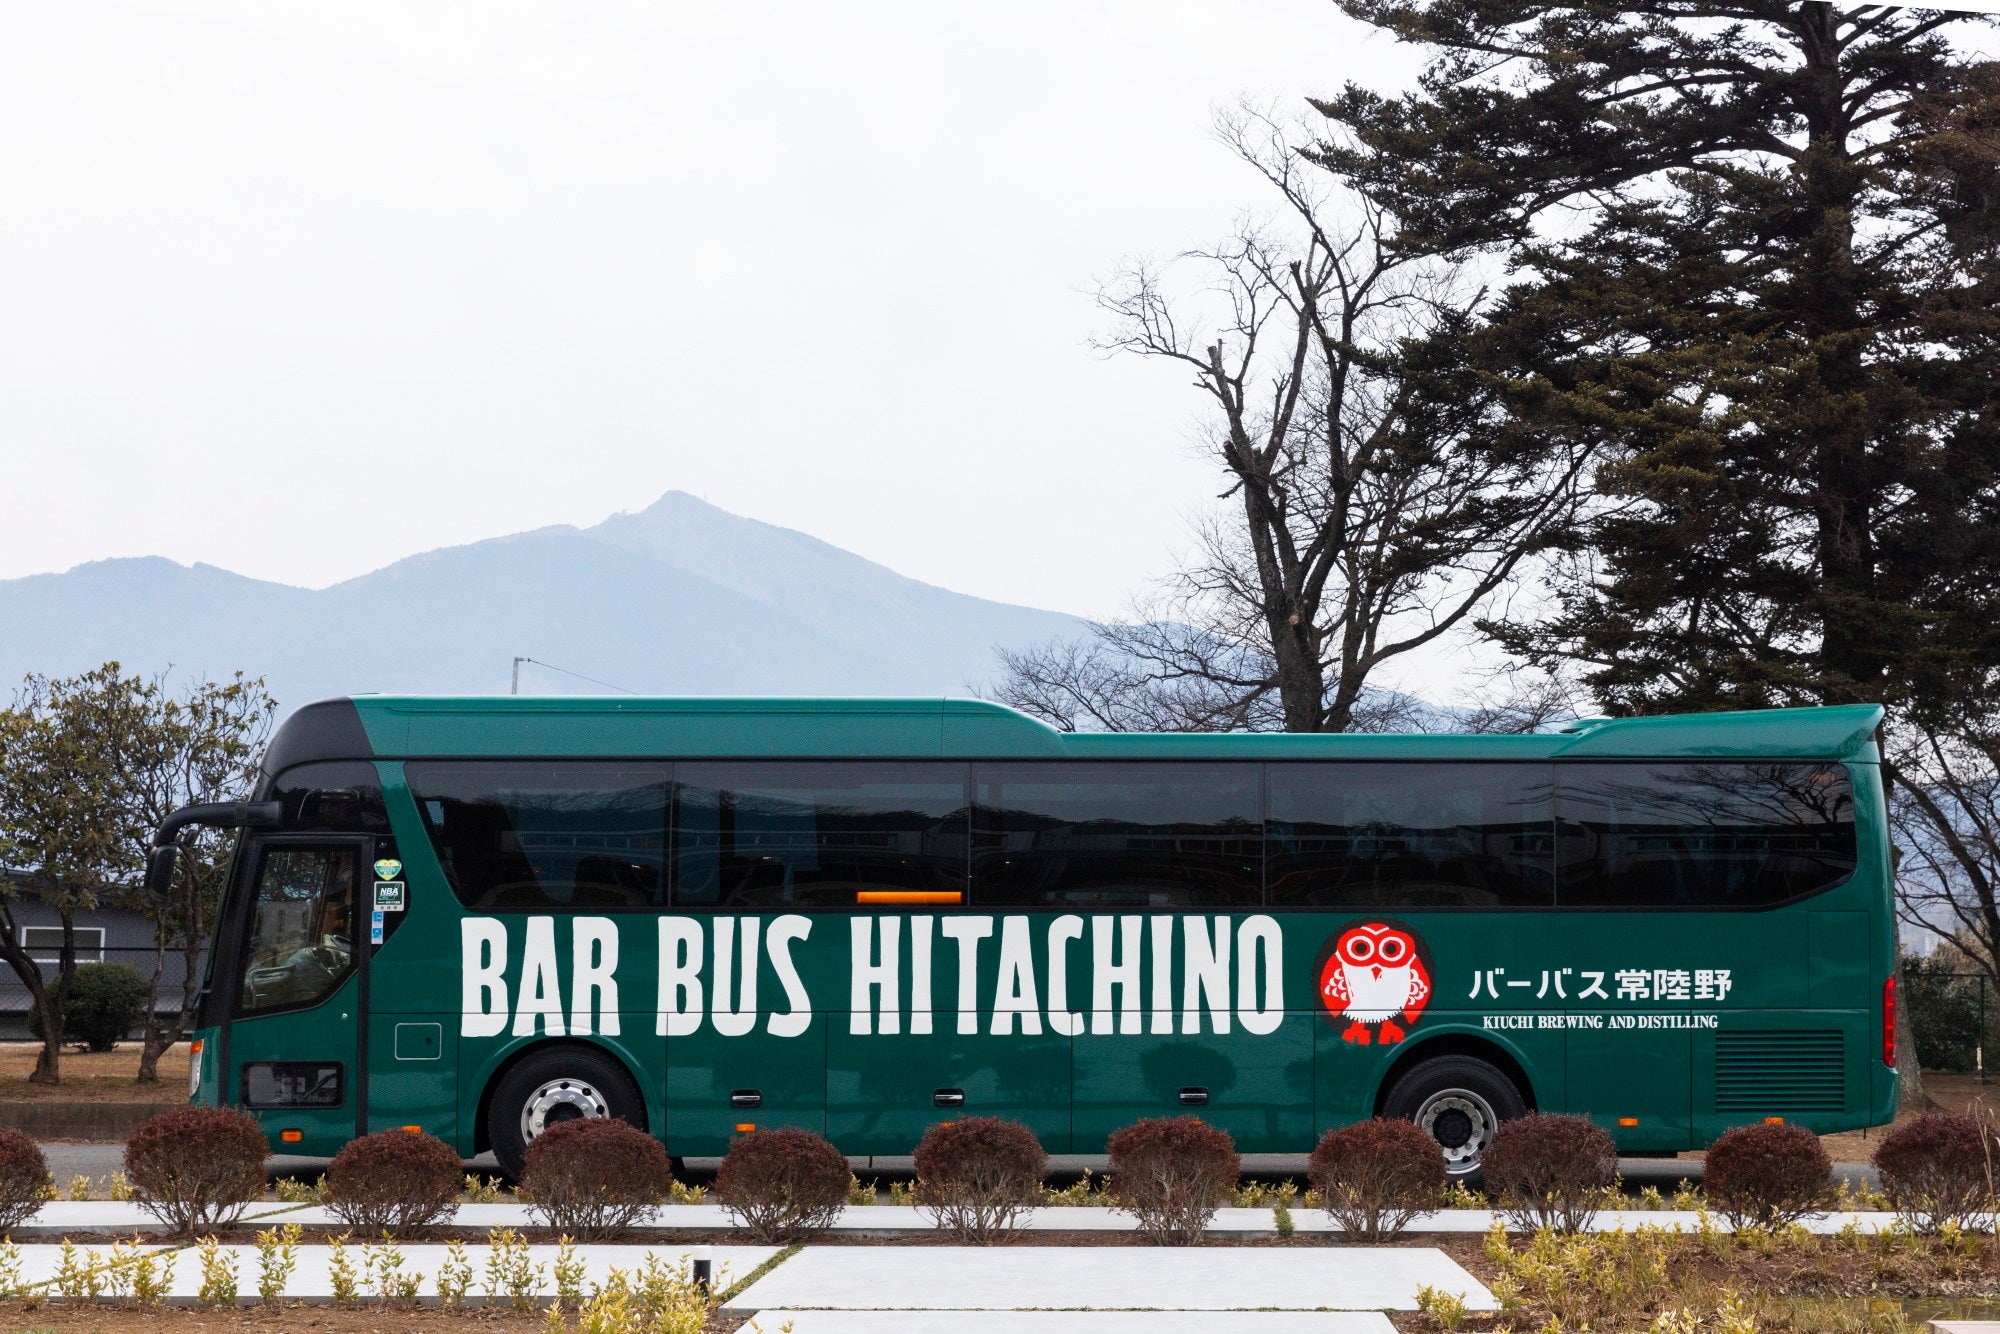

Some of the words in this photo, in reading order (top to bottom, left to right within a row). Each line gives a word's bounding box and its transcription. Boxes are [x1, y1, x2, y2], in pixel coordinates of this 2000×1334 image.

[380, 887, 398, 896] NBA
[460, 915, 621, 1038] BAR
[655, 914, 813, 1038] BUS
[849, 914, 1284, 1036] HITACHINO
[1468, 967, 1732, 1001] バーバス常陸野
[1482, 1015, 1534, 1029] KIUCHI
[1537, 1015, 1604, 1029] BREWING
[1607, 1015, 1636, 1029] AND
[1637, 1014, 1719, 1029] DISTILLING
